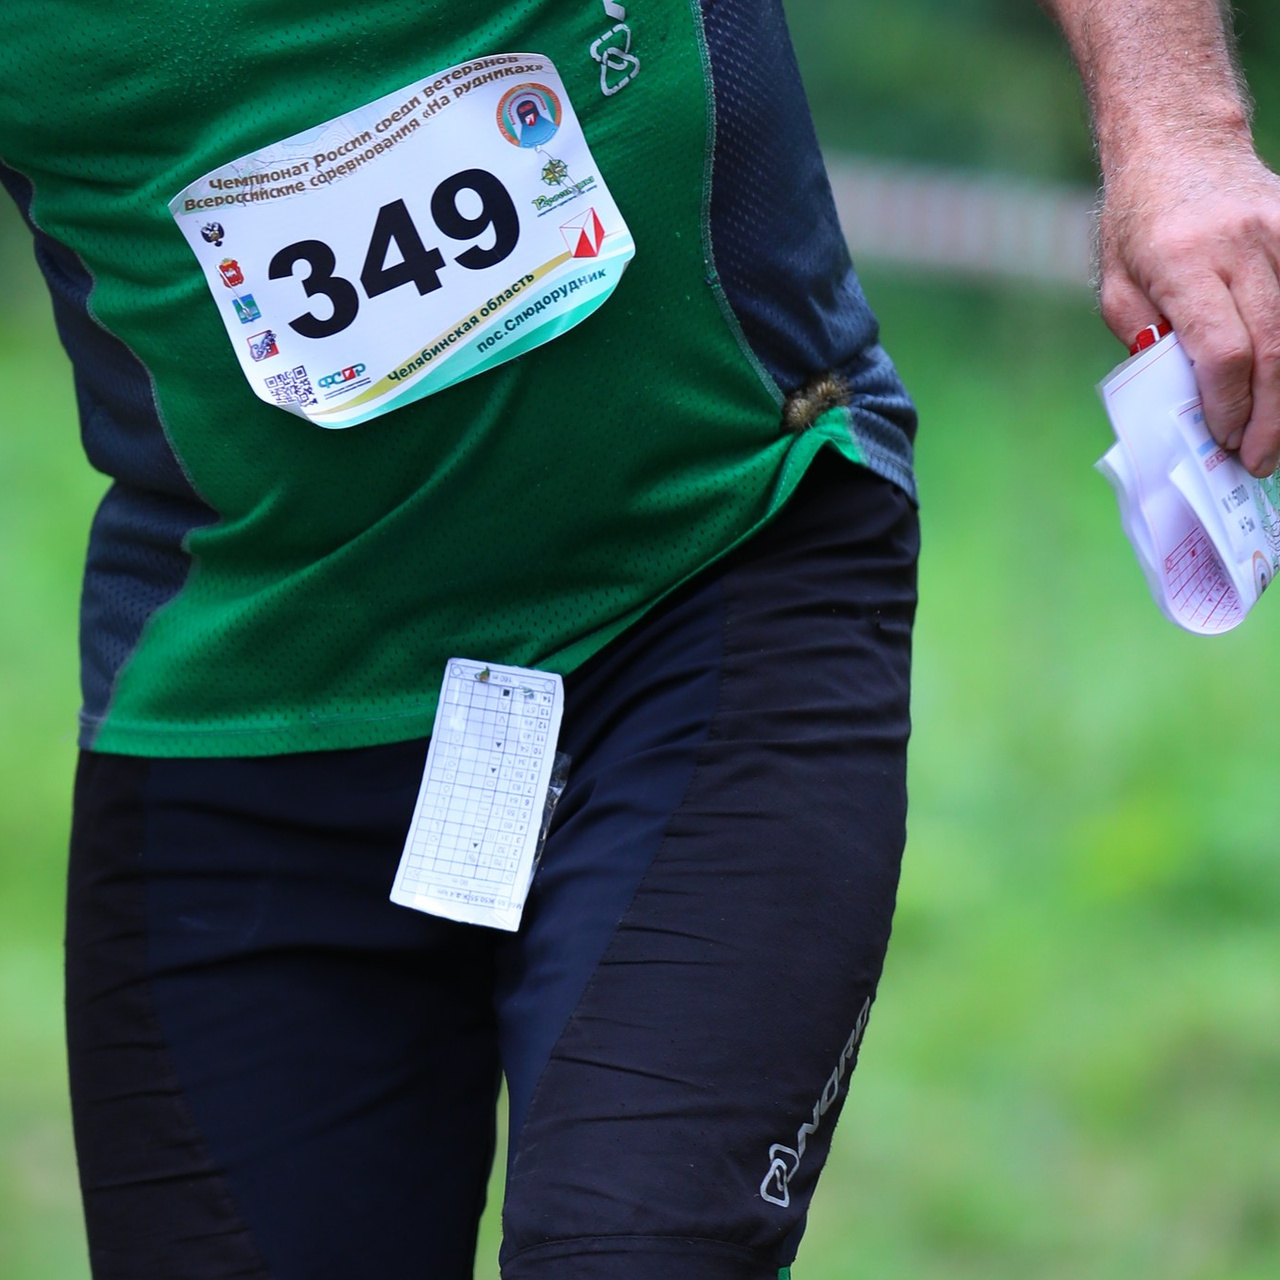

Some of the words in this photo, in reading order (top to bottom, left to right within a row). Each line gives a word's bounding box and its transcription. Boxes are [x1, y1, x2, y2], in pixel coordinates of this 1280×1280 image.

[185, 181, 305, 211] Всероссийские
[310, 118, 420, 187] соревнования
[422, 95, 451, 119] «На
[452, 64, 543, 98] рудниках»
[209, 161, 309, 191] Чемпионат
[313, 131, 371, 168] России
[375, 94, 421, 134] среди
[422, 56, 519, 98] ветеранов
[268, 168, 520, 339] 349
[387, 314, 480, 382] Челябинская
[480, 272, 535, 318] область
